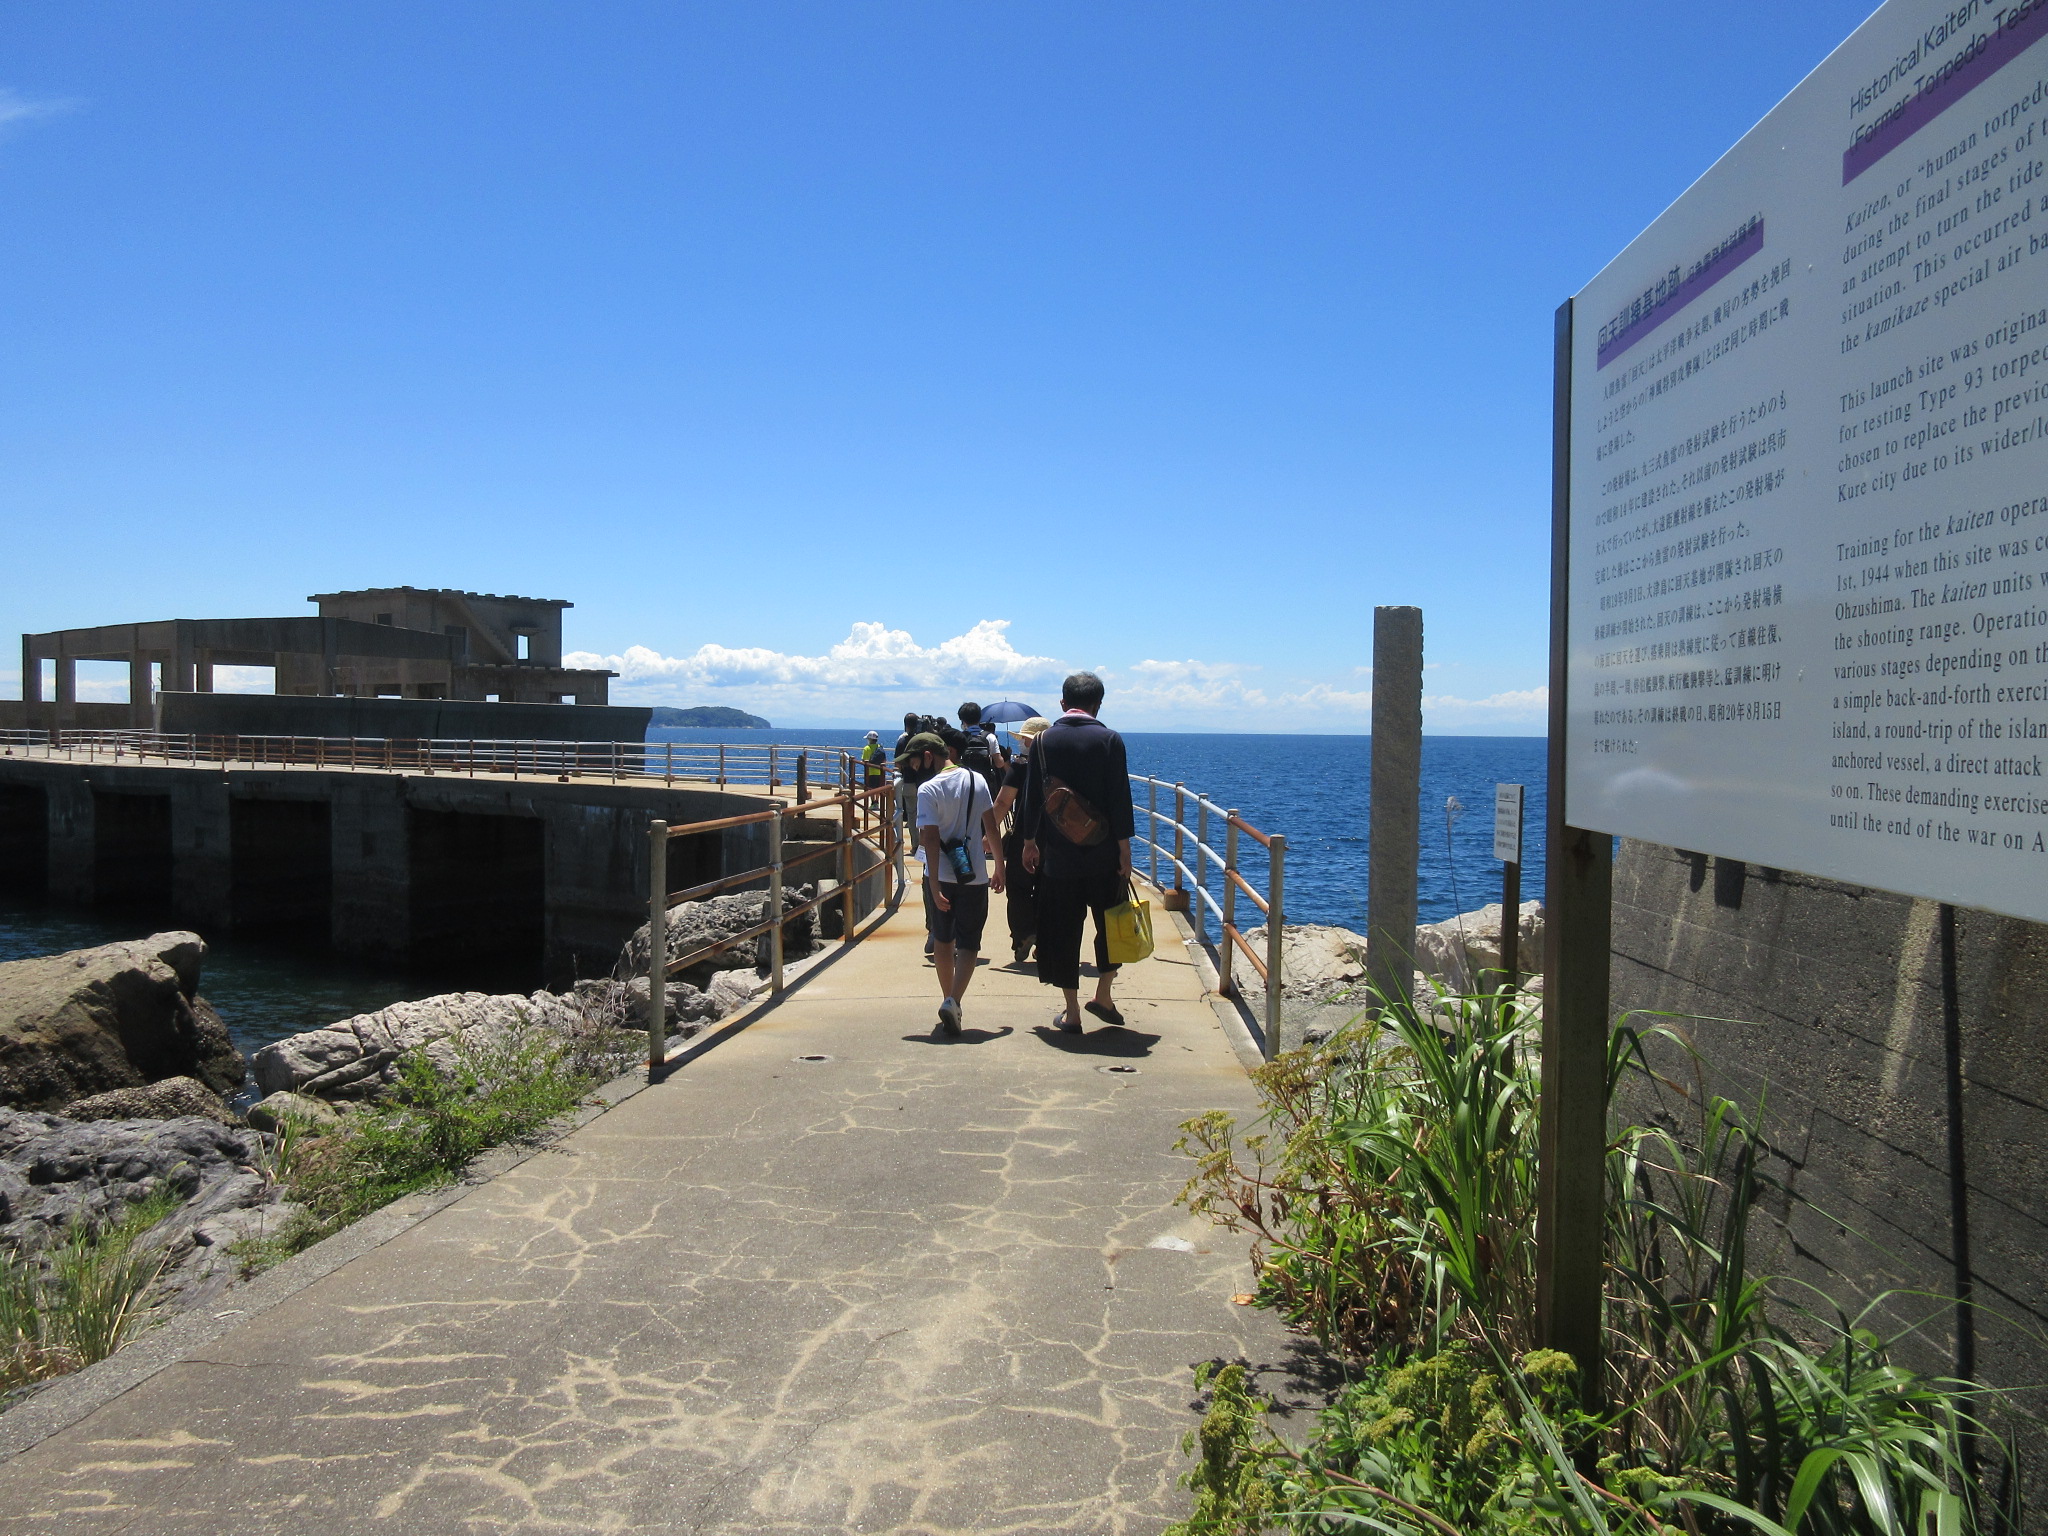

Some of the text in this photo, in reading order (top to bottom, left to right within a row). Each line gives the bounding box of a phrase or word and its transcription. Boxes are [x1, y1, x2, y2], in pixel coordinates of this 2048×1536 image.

[1850, 0, 1978, 119] Historical Kaiten
[1848, 92, 1909, 155] (Former
[1914, 32, 1988, 103] Torpedo
[1843, 230, 1883, 264] during
[1889, 211, 1908, 235] the
[1915, 179, 1950, 217] final
[1957, 147, 2006, 190] stages
[2015, 122, 2034, 152] of
[1897, 177, 1910, 197] or
[1842, 160, 2043, 294] an attempt to turn the tide
[1841, 280, 1906, 324] situation.
[1914, 254, 1946, 283] This
[1954, 201, 2031, 261] occurred
[1597, 265, 1681, 354] 回天訓練基地跡
[1841, 334, 1859, 354] the
[1865, 295, 1929, 342] kamikaze
[1934, 260, 1989, 307] special
[1998, 247, 2022, 272] air
[1840, 308, 2047, 413] This launch site was origina
[1839, 423, 1857, 443] for
[1864, 403, 1911, 434] testing
[1919, 384, 1956, 412] Type
[1965, 367, 1983, 393] 93
[1839, 446, 1880, 472] chosen
[1886, 440, 1897, 455] to
[1904, 418, 1956, 450] replace
[1963, 406, 1987, 427] the
[1838, 480, 1867, 502] Kure
[1872, 471, 1897, 491] city
[1903, 462, 1927, 482] due
[1933, 456, 1947, 471] to
[1954, 445, 1973, 465] its
[1837, 496, 2048, 561] Training for the kaiten opera
[1862, 565, 1889, 587] 1944
[1894, 561, 1928, 578] when
[1934, 551, 1959, 571] this
[1965, 545, 1992, 566] site
[1999, 539, 2028, 557] was
[1836, 596, 1905, 620] Ohzushima.
[1911, 589, 1935, 608] The
[1941, 581, 1987, 603] kaiten
[1993, 572, 2032, 595] units
[1834, 606, 2047, 650] the shooting range. Operatio
[1834, 662, 1876, 679] various
[1881, 658, 1920, 679] stages
[1926, 648, 2002, 677] depending
[2009, 649, 2028, 665] on
[1834, 679, 2047, 713] a simple back-and-forth exerci
[1832, 717, 2047, 744] island, a round-trip of the islan
[1832, 752, 2041, 776] anchored vessel, a direct attack
[1831, 783, 2048, 814] so on. These demanding exercise
[1831, 812, 2045, 852] until the end of the war on A
